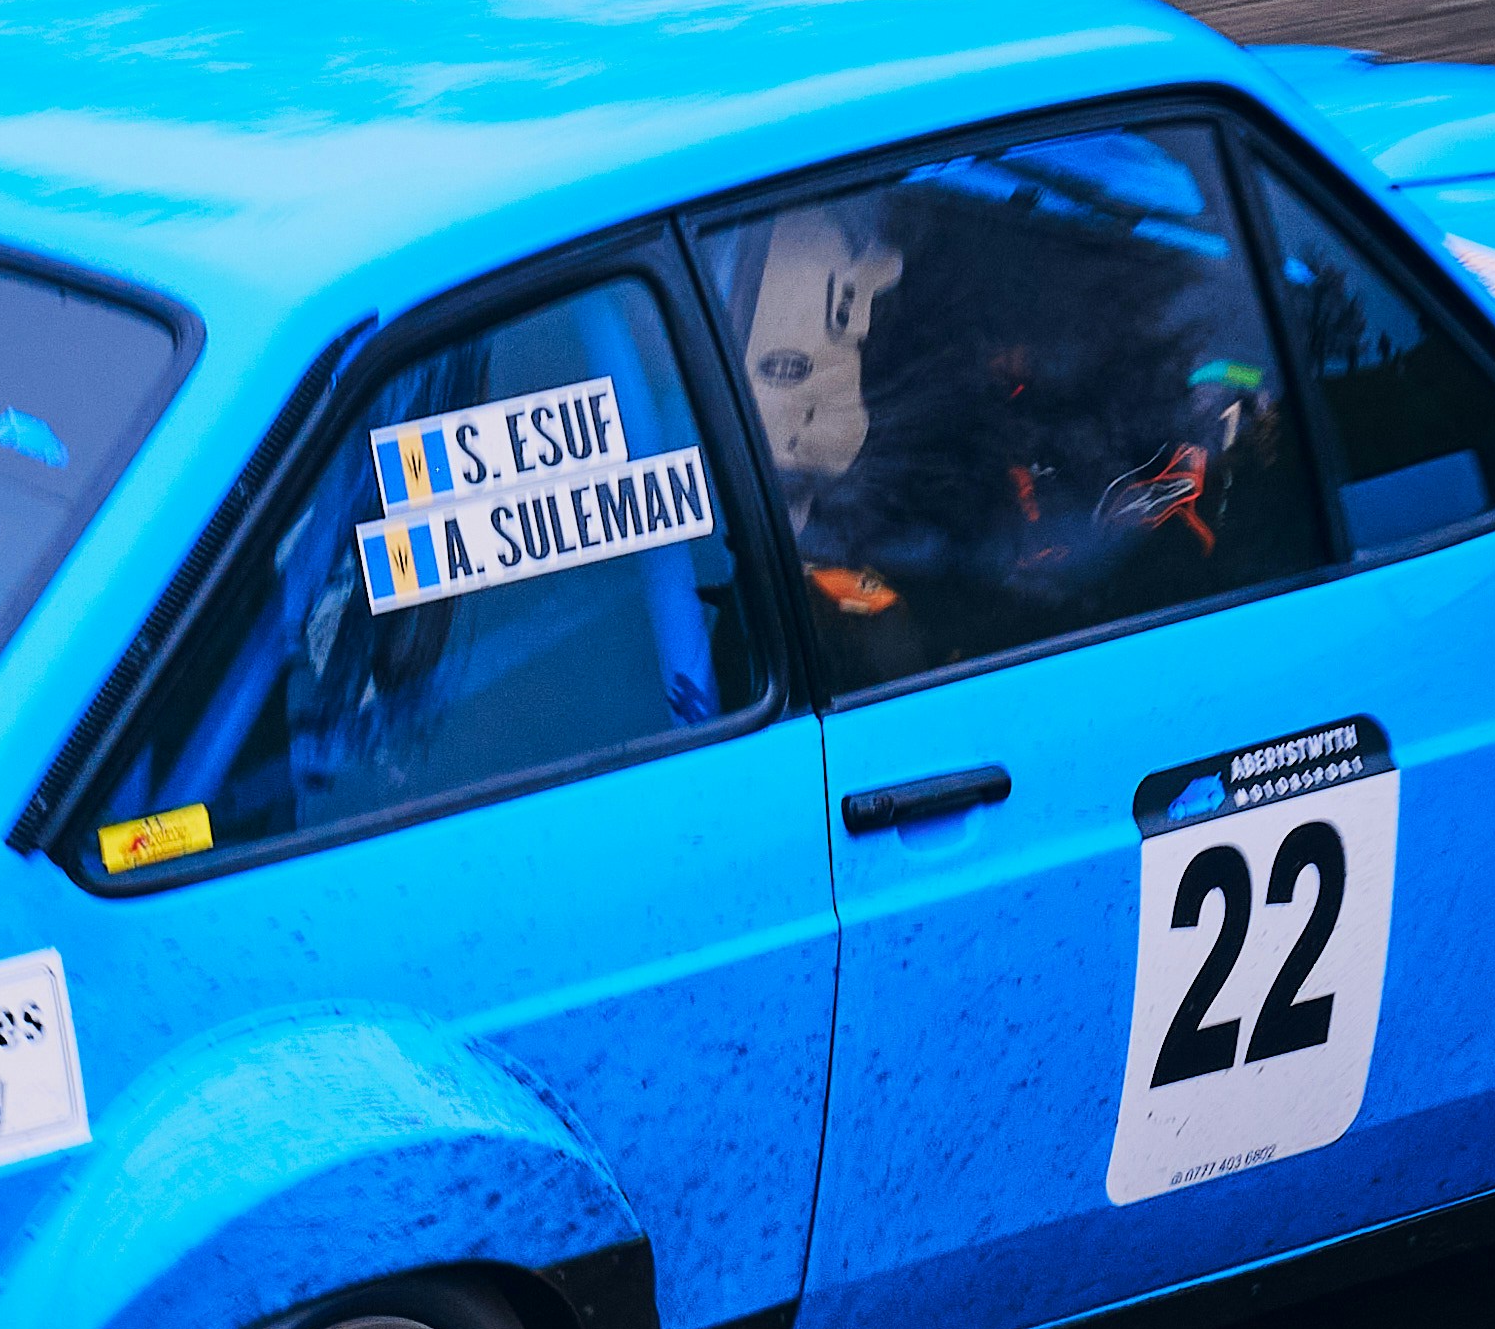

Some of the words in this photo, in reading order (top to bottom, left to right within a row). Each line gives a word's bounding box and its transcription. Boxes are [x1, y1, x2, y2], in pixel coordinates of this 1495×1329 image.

[455, 424, 502, 485] S.
[505, 390, 612, 473] ESUF
[444, 517, 486, 580] A.
[490, 462, 705, 568] SULEMAN
[1230, 723, 1358, 783] ABERYSTWYTH
[1234, 755, 1364, 808] MOTORSPORT
[1149, 820, 1348, 1089] 22
